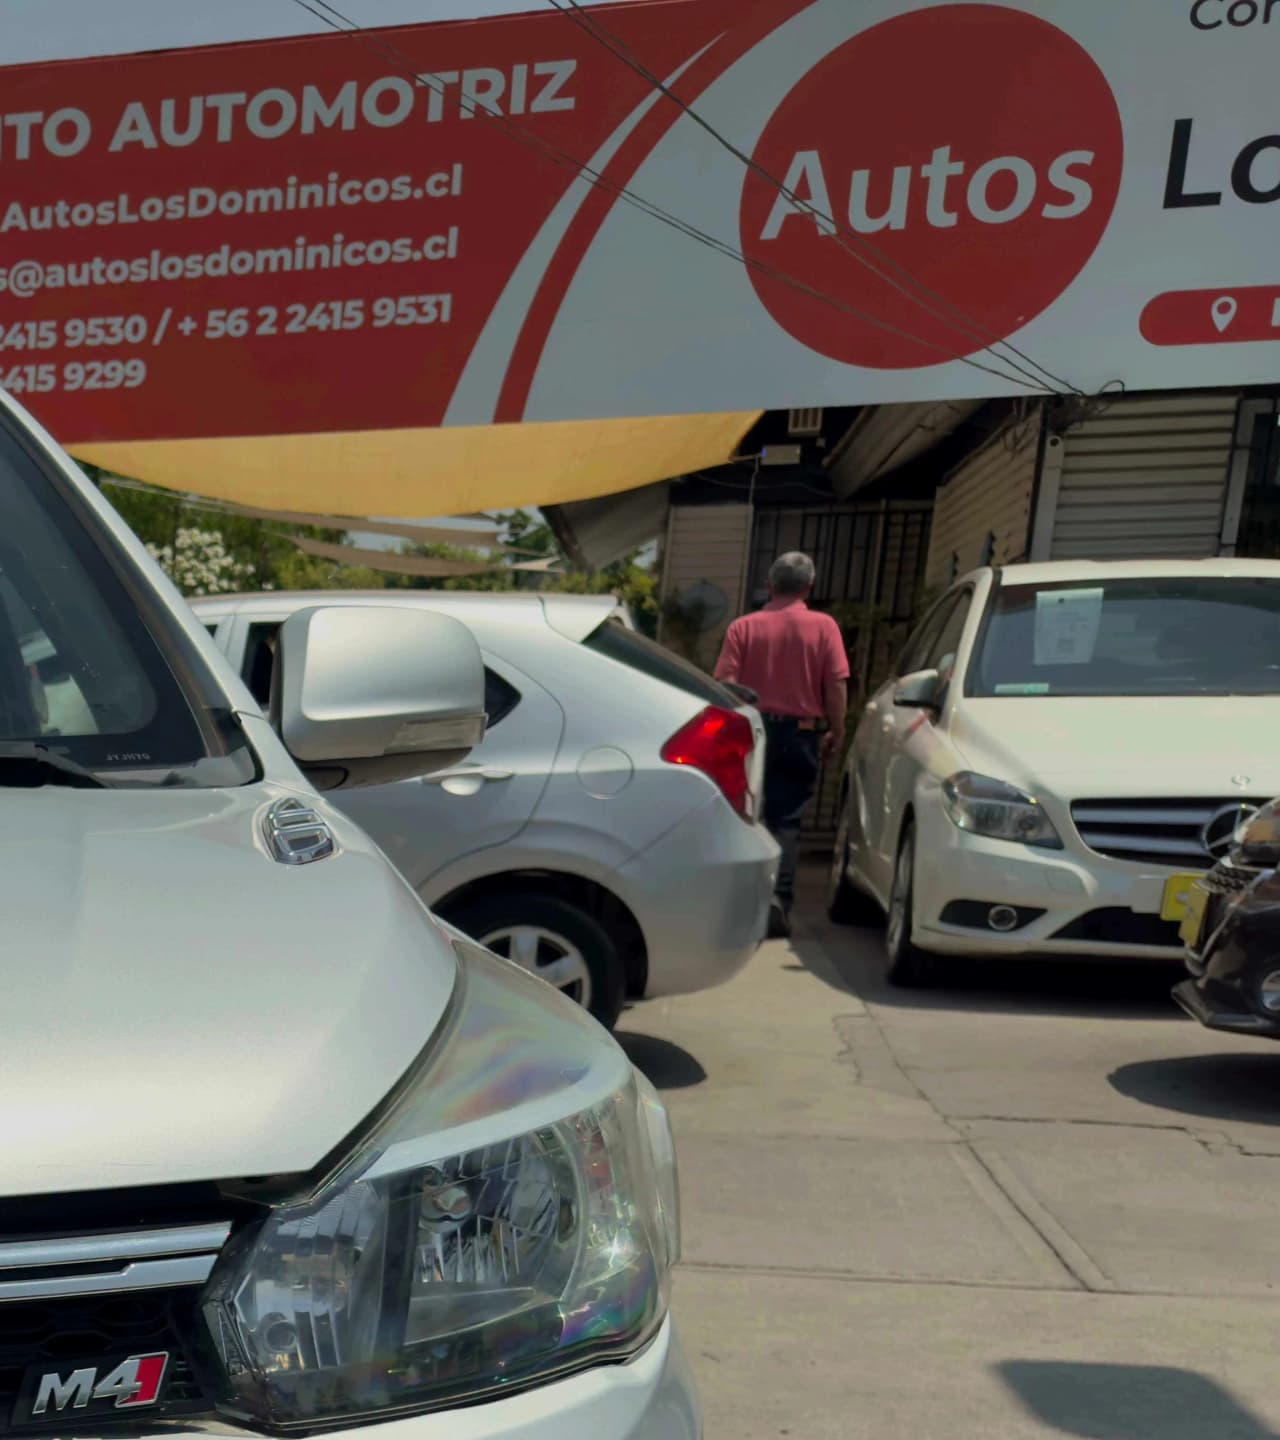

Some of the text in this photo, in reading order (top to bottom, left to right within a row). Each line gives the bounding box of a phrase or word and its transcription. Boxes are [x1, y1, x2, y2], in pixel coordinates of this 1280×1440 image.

[109, 59, 577, 152] AUTOMOTRIZ
[760, 144, 1095, 241] Autos
[65, 314, 147, 347] 9530
[206, 309, 248, 338] 56
[256, 307, 277, 335] 2
[285, 302, 364, 332] 2415
[373, 294, 452, 327] 9531
[63, 359, 146, 392] 9299
[32, 1352, 168, 1414] M4
